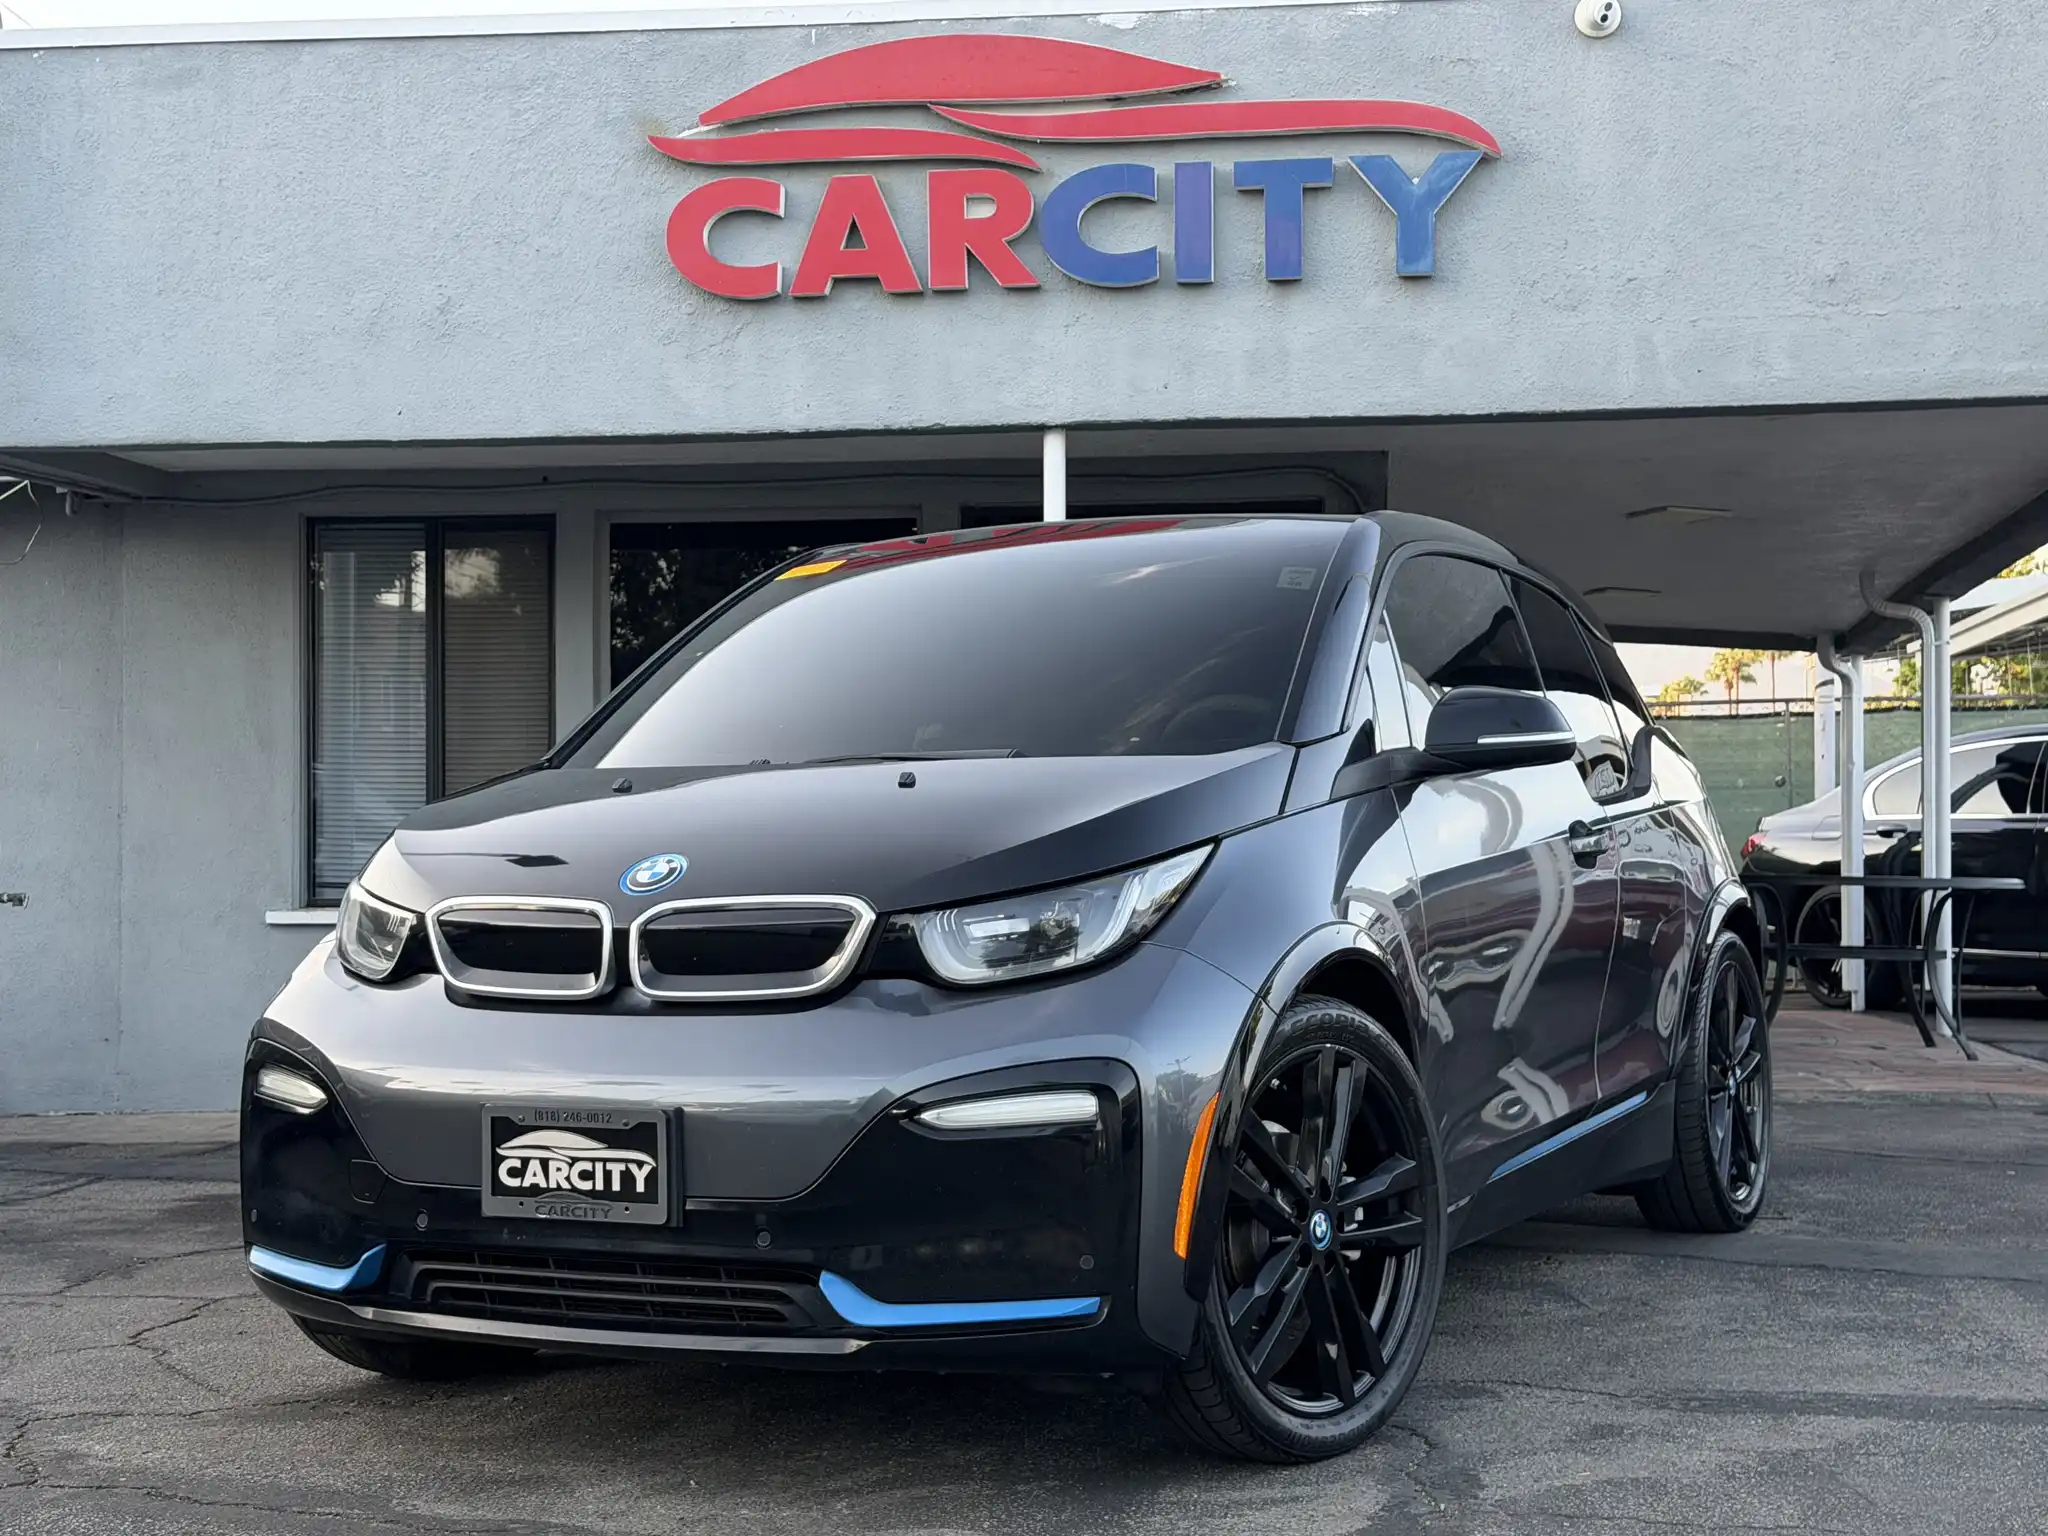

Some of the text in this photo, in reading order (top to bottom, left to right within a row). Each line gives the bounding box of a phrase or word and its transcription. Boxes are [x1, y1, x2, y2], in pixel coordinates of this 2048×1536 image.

[665, 150, 1485, 300] CARCITY
[534, 1109, 612, 1124] (818) 246-0012
[498, 1158, 654, 1192] CARCITY
[534, 1204, 612, 1219] CARCITY
